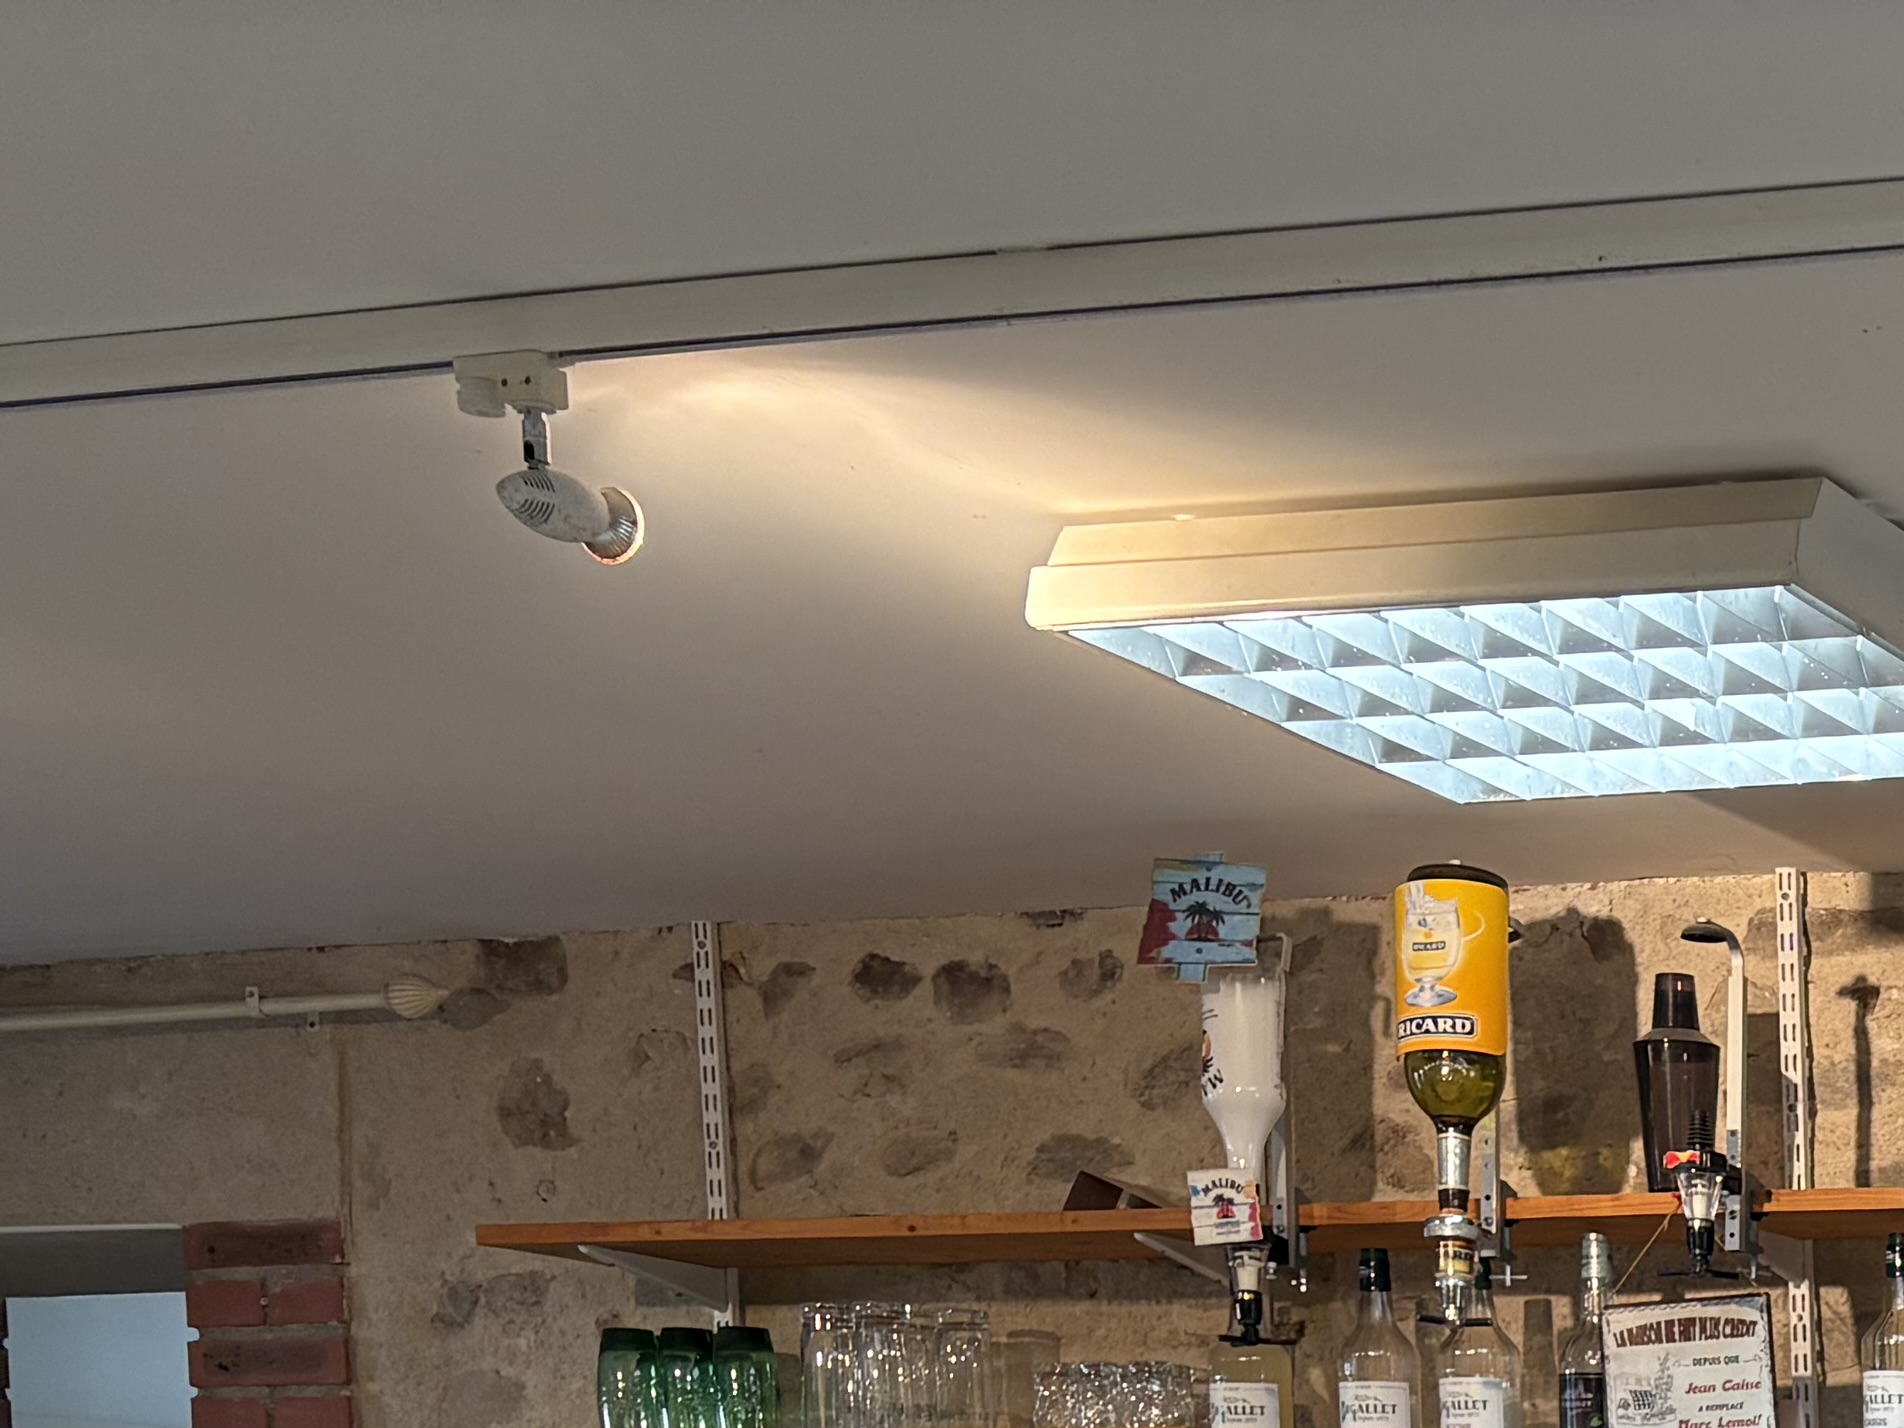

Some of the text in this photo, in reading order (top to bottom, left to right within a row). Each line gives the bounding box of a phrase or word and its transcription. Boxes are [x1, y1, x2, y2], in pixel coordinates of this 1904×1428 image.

[1170, 876, 1252, 910] MALIBU
[1398, 1017, 1471, 1038] RICARD
[1202, 1177, 1244, 1198] MALIBU
[1699, 1317, 1721, 1341] PLUS
[1692, 1356, 1721, 1367] DEPUIS
[1684, 1382, 1716, 1395] Jean
